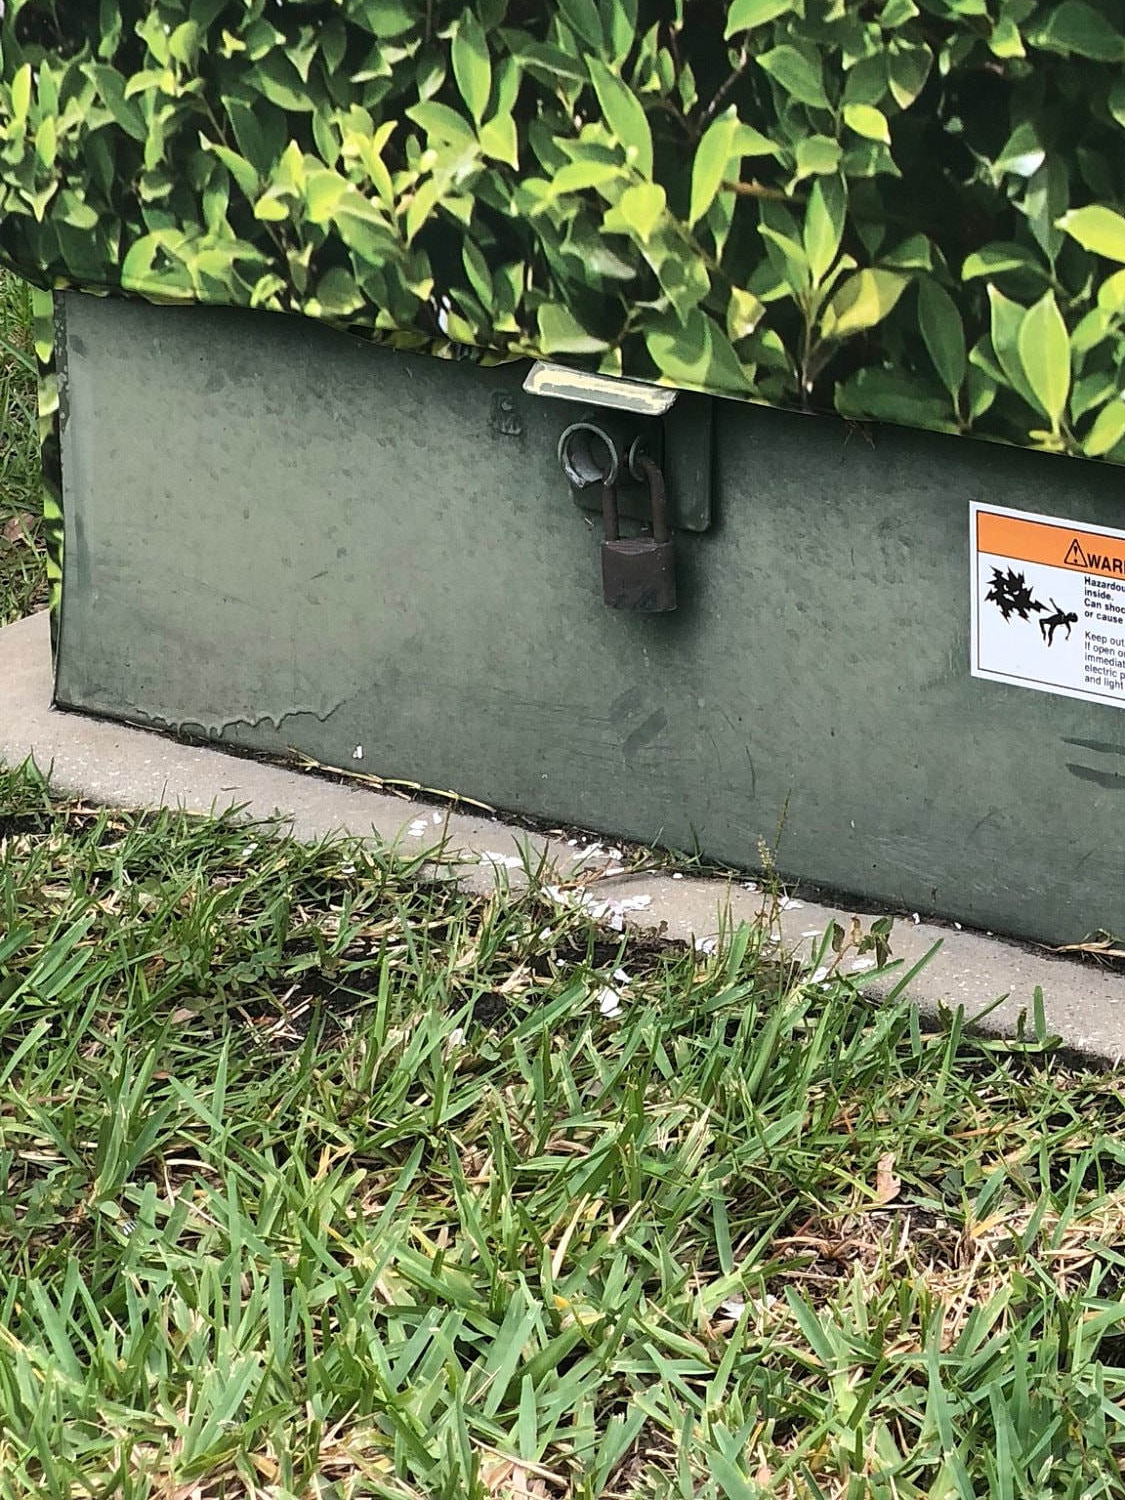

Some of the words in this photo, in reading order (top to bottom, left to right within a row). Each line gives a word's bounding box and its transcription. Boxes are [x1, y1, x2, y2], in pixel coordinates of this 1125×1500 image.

[1085, 586, 1114, 601] inside.
[1084, 598, 1102, 609] Can
[1096, 613, 1123, 624] cause
[1085, 631, 1107, 644] Keep
[1110, 638, 1125, 647] out.
[1085, 641, 1090, 650] If
[1093, 645, 1115, 655] open
[1085, 664, 1117, 677] electric
[1085, 676, 1101, 685] and
[1104, 678, 1123, 690] light
